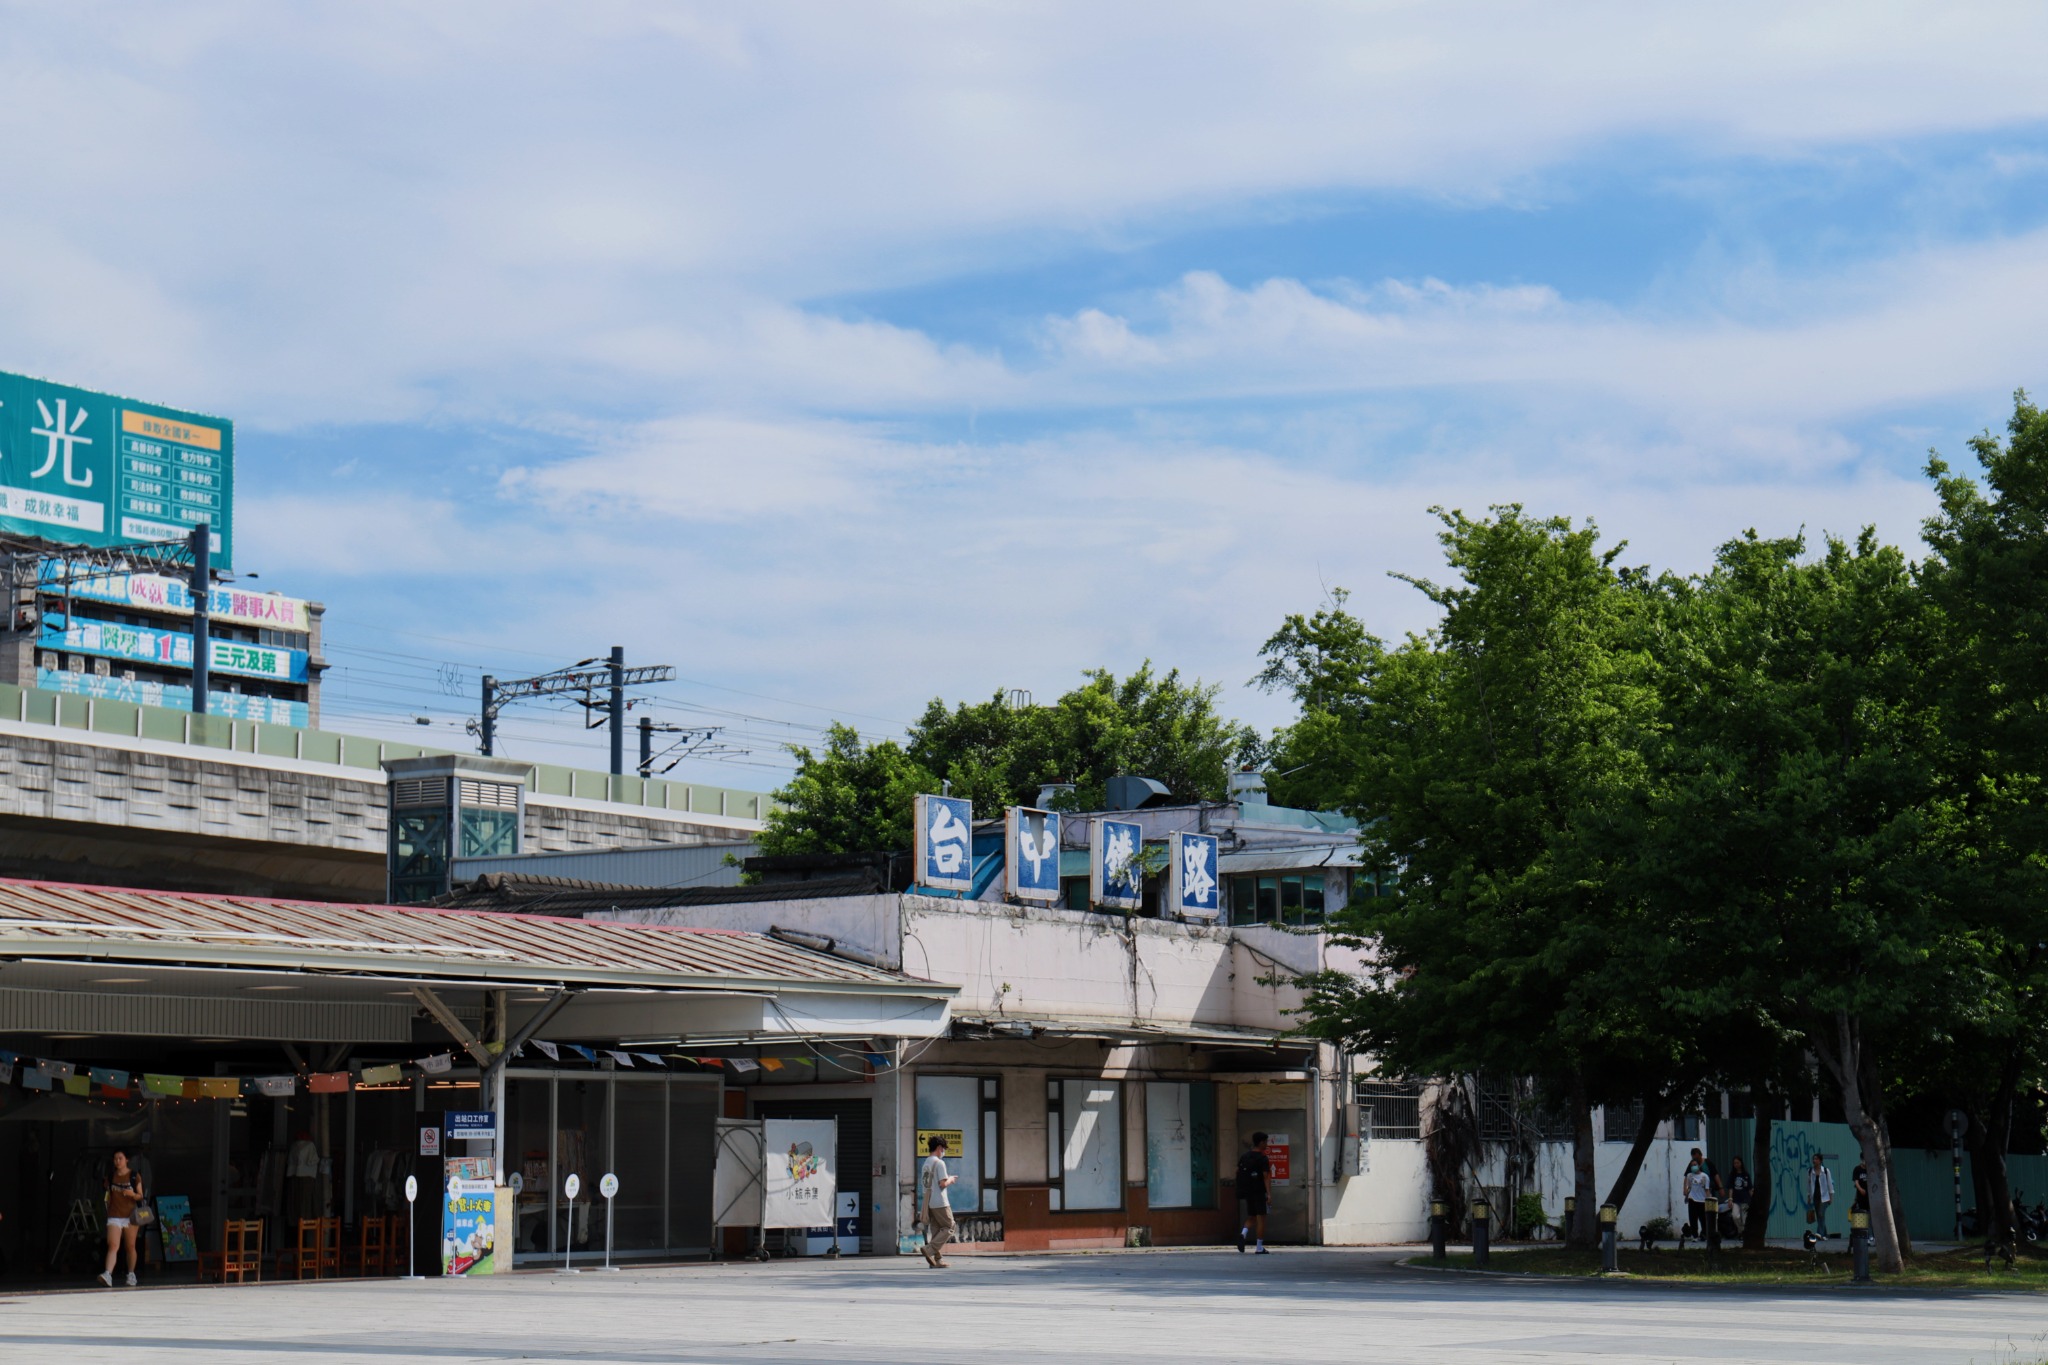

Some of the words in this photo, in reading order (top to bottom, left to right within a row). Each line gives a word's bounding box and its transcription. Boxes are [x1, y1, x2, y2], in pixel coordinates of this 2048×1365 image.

[0, 398, 93, 488] 光
[181, 451, 212, 467] 地方特考
[214, 645, 277, 674] 三元及第
[929, 803, 968, 873] 台
[1183, 839, 1215, 903] 路
